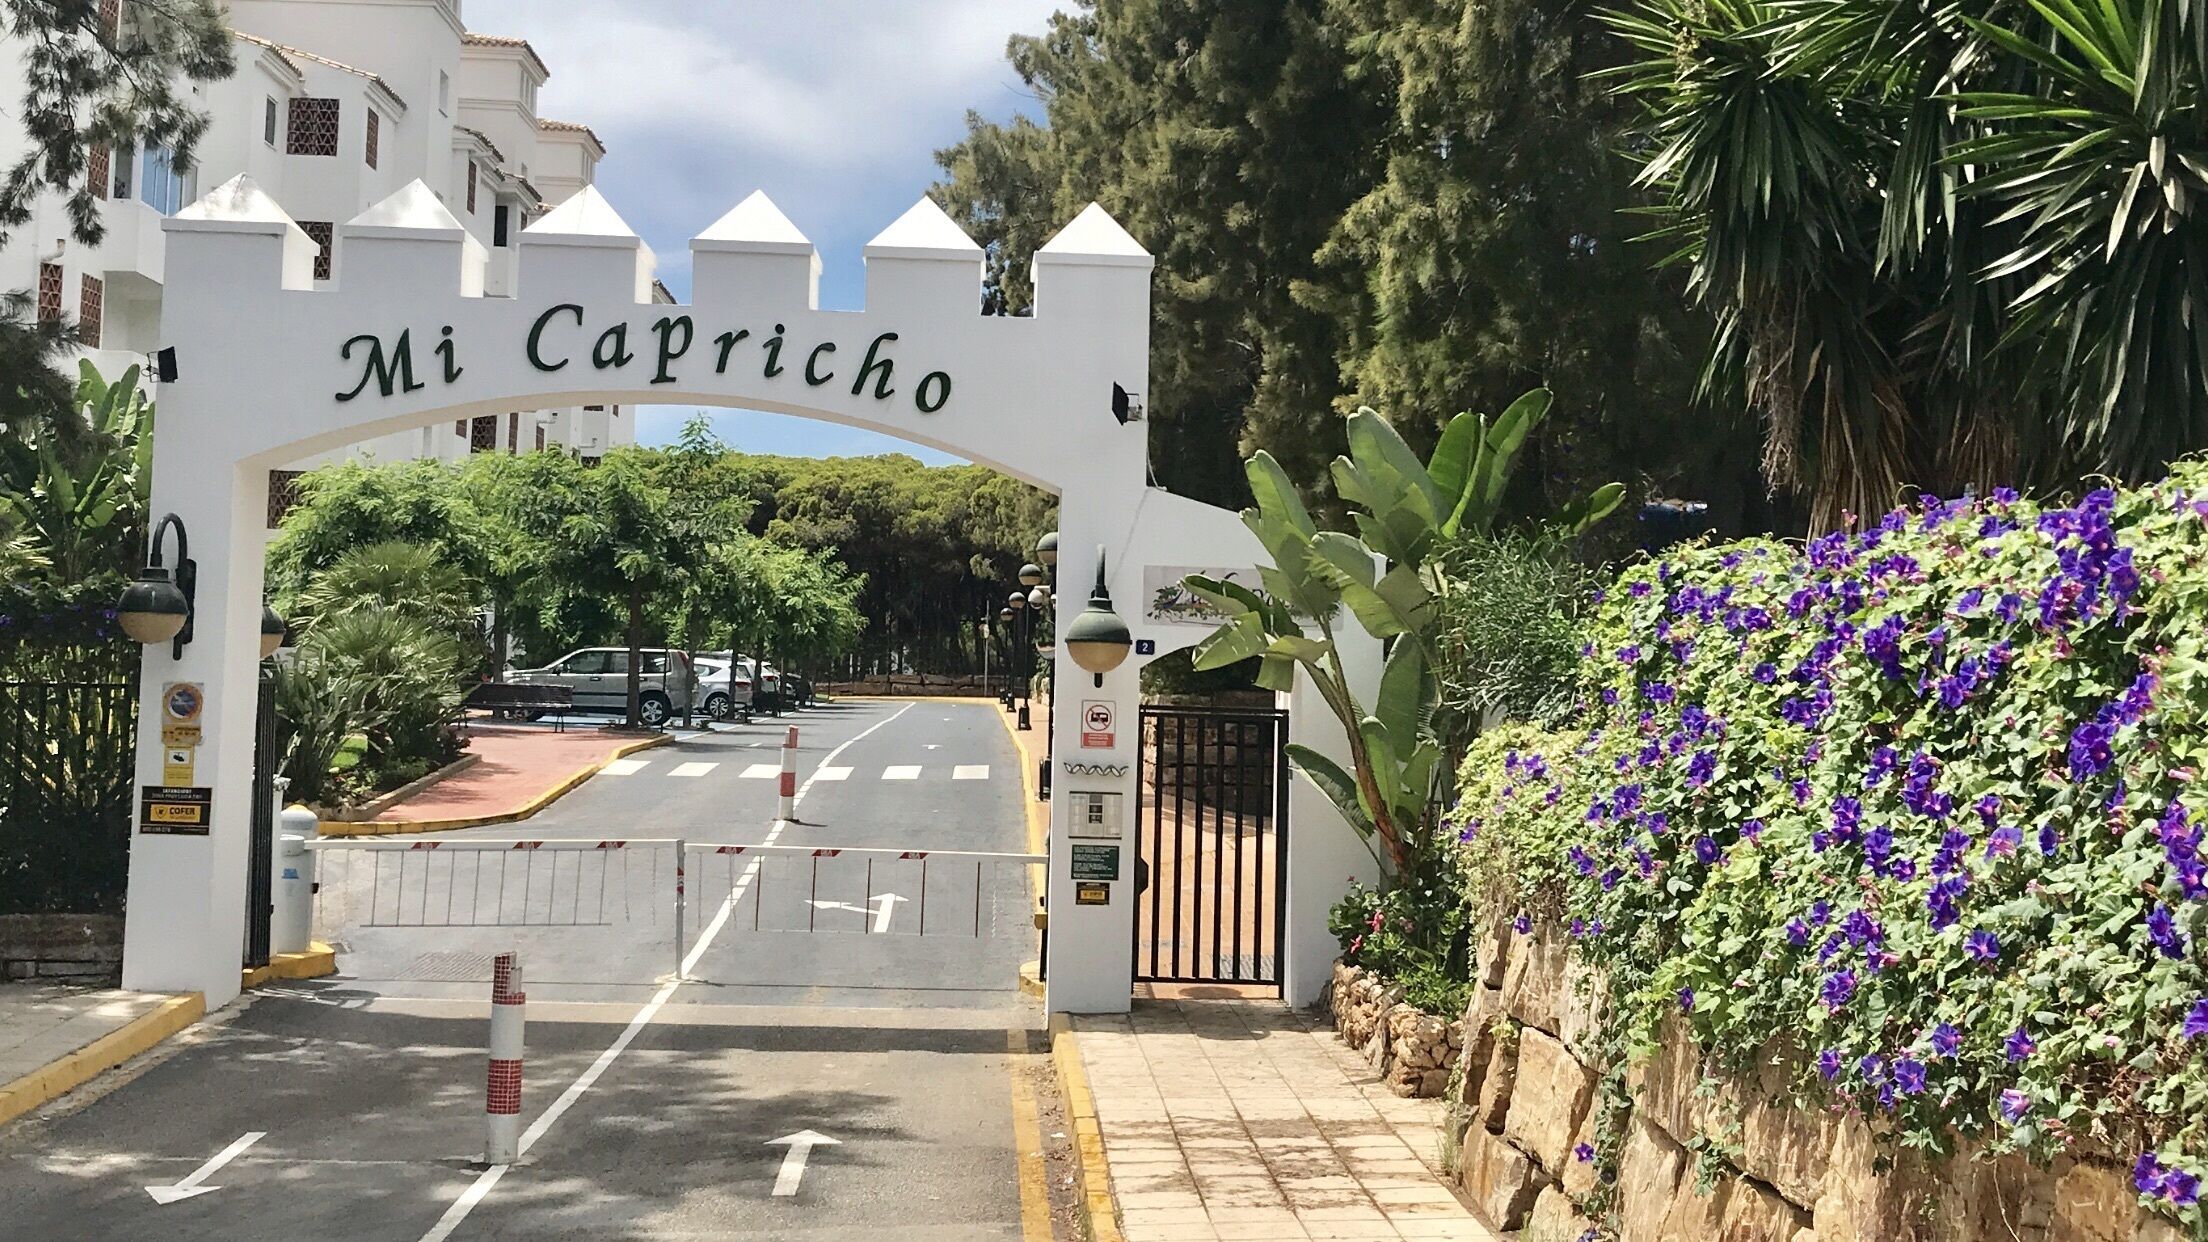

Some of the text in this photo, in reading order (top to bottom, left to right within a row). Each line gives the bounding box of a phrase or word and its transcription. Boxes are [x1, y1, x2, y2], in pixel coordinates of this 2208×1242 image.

[335, 303, 952, 413] Mi Capricho
[1142, 642, 1148, 651] 2
[169, 807, 195, 815] COFER
